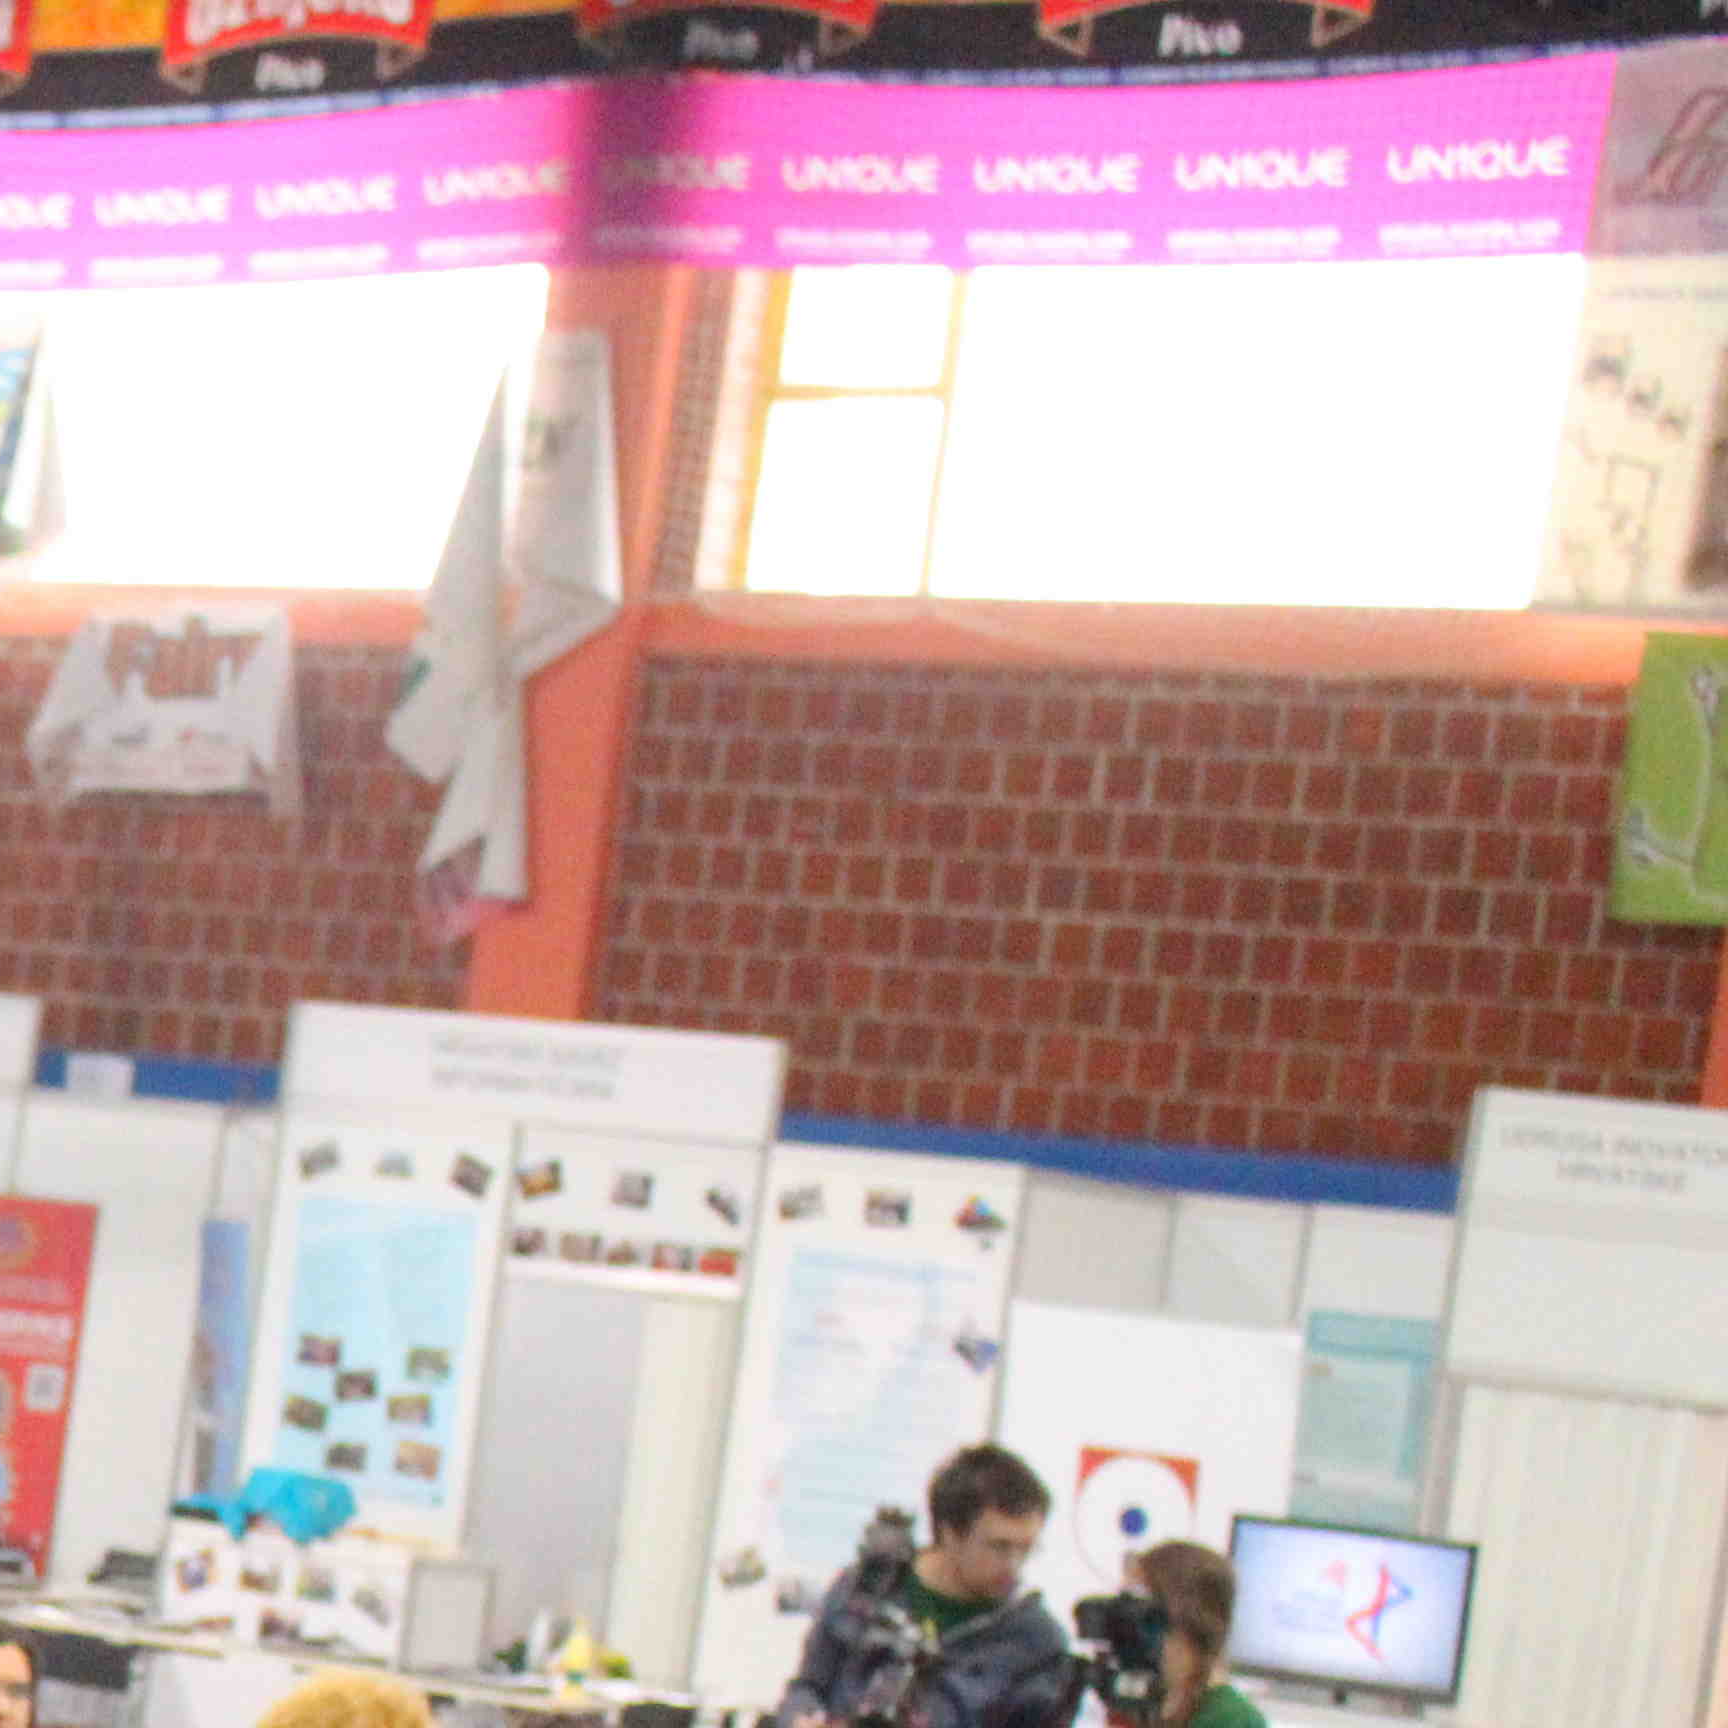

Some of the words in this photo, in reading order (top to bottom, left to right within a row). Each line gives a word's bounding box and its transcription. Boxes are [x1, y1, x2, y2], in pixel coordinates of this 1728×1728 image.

[779, 151, 942, 196] UNIQUE
[972, 151, 1141, 195] UNIQUE
[1172, 144, 1352, 192] UNIQUE
[1385, 134, 1572, 185] UNIQUE
